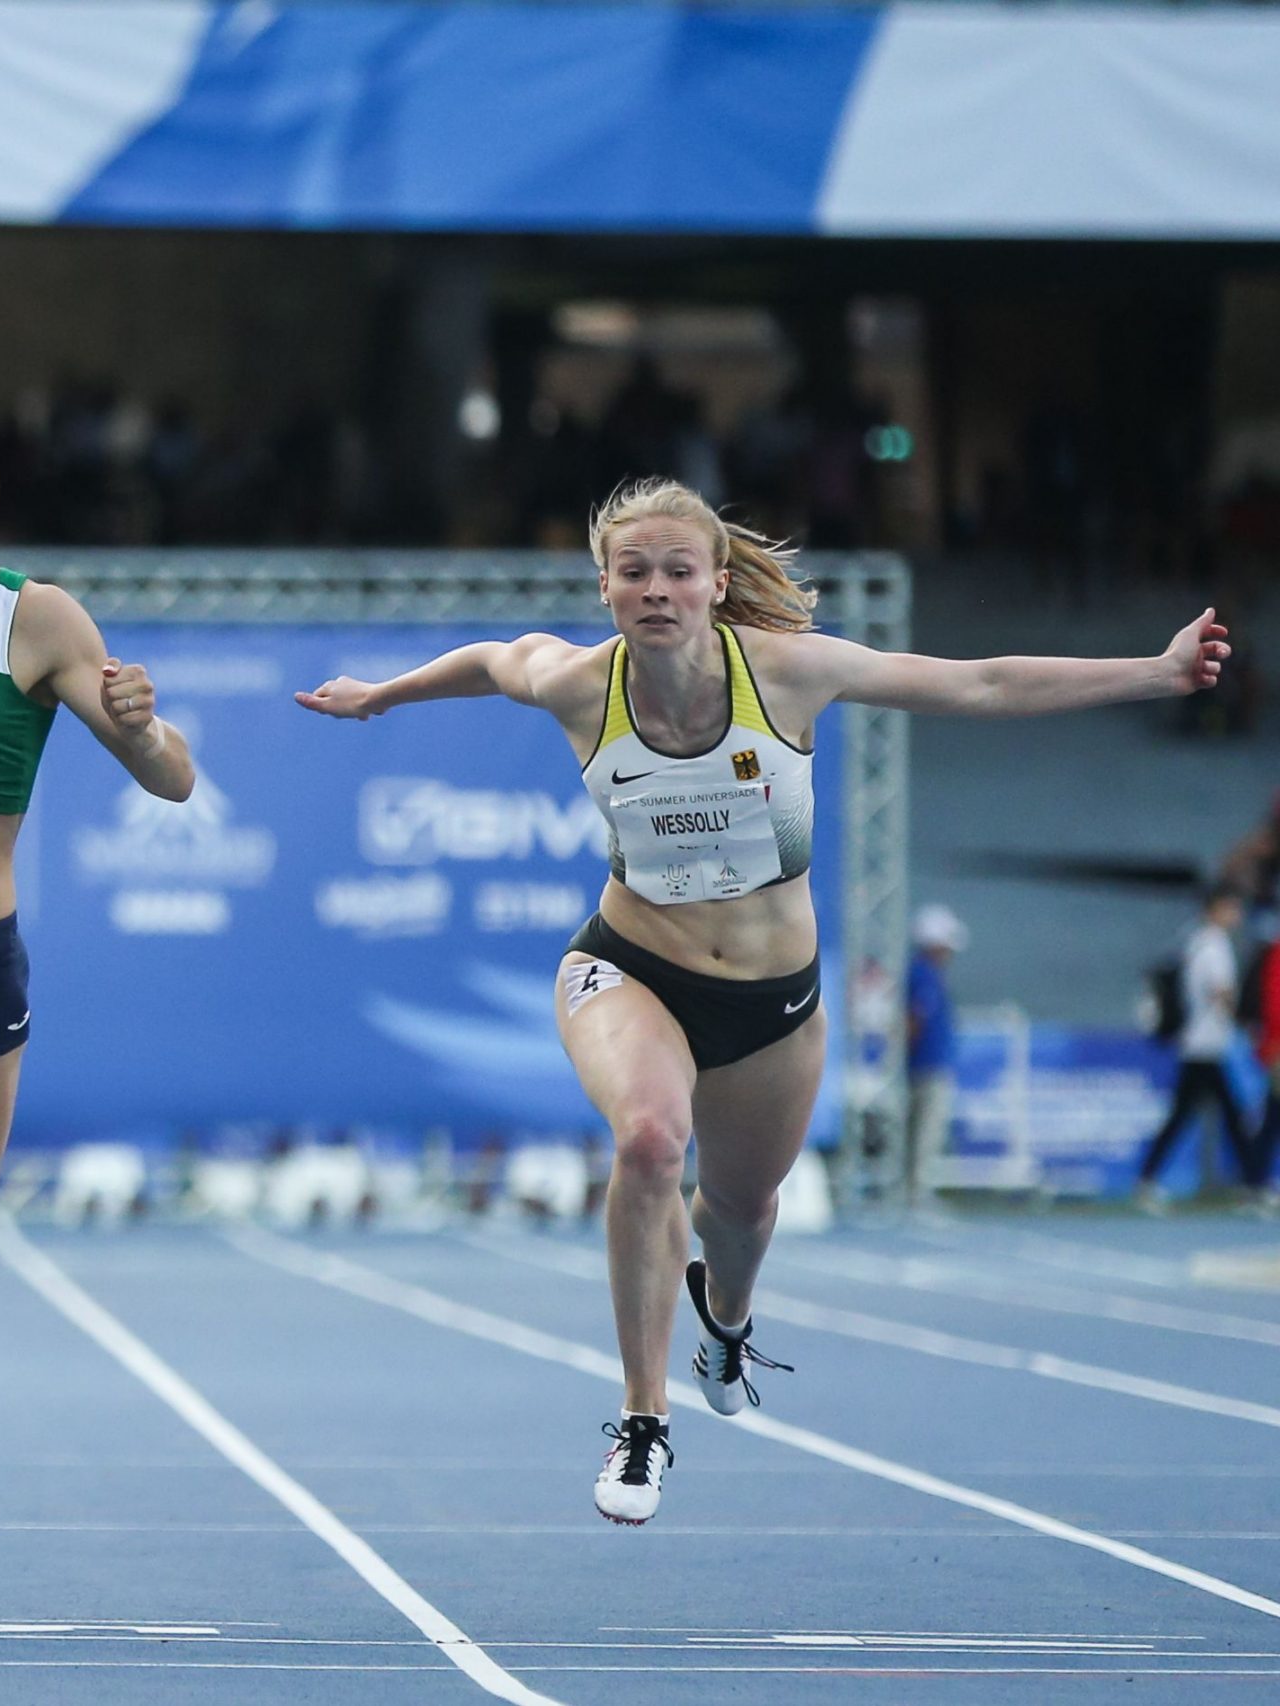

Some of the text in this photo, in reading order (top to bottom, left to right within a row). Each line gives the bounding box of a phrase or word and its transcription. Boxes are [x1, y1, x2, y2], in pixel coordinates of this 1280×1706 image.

[640, 795, 687, 808] SUMMER
[689, 787, 759, 804] UNIVERSIADE
[650, 809, 730, 836] WESSOLLY
[581, 964, 599, 992] 4
